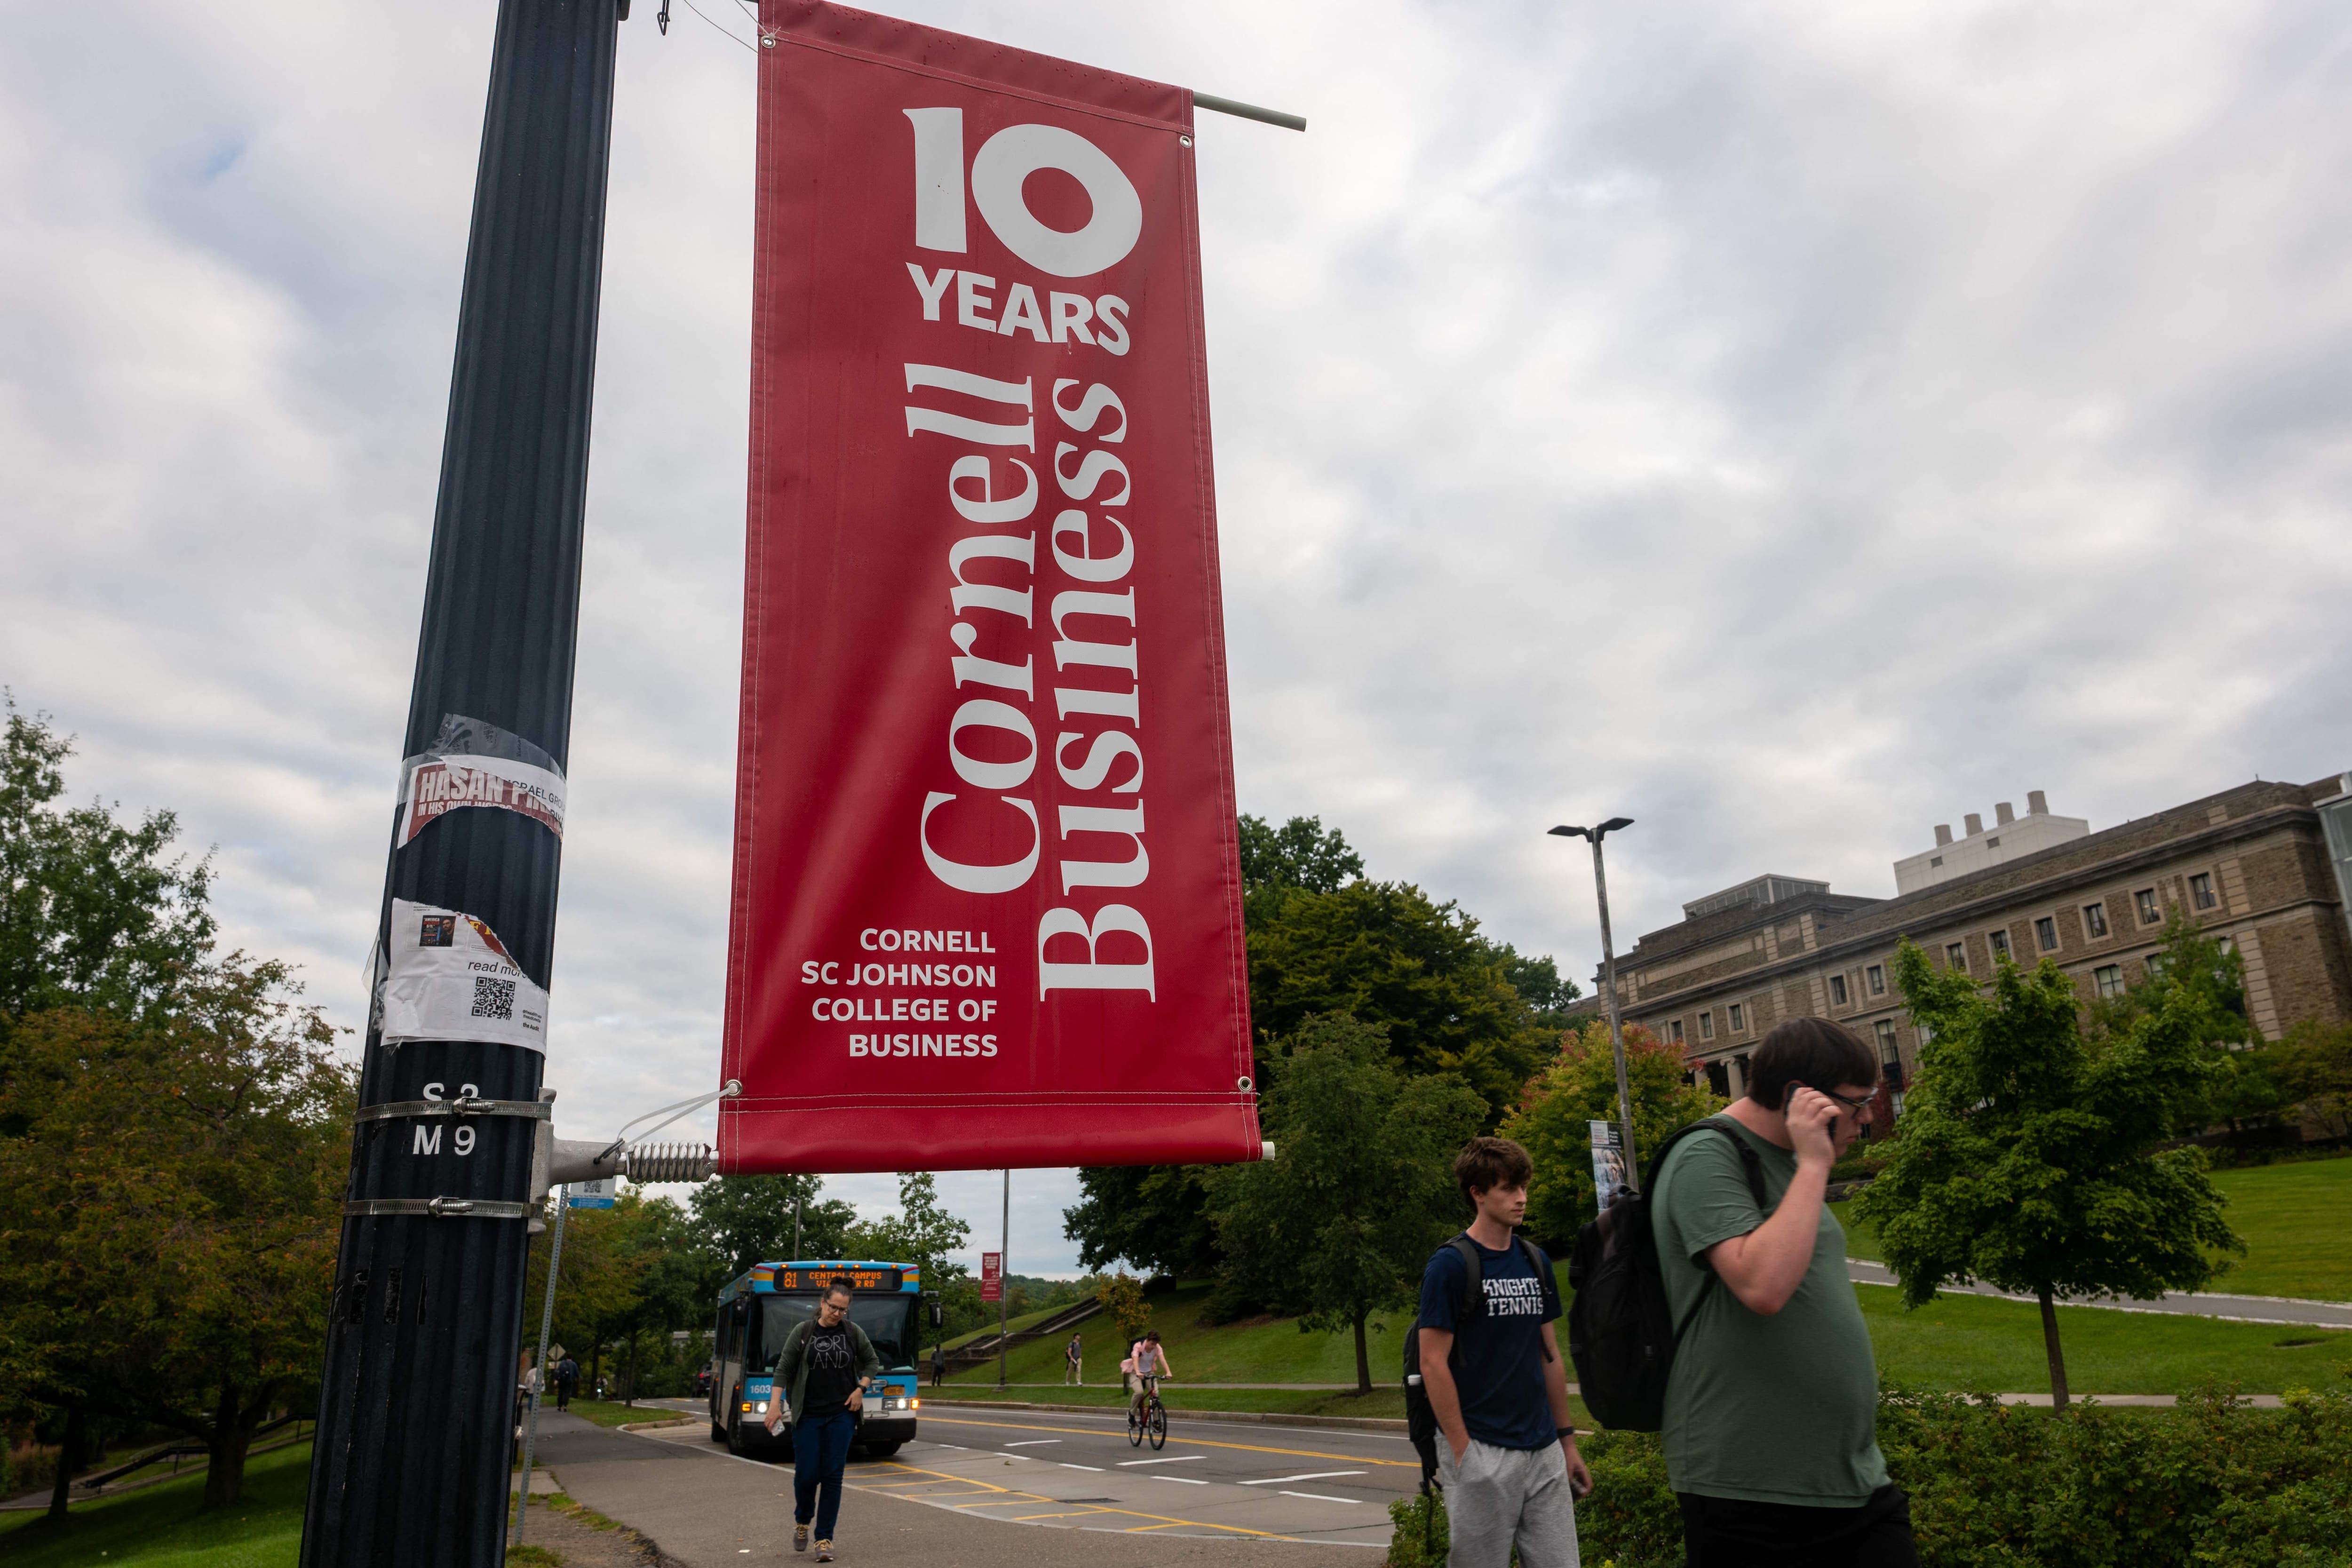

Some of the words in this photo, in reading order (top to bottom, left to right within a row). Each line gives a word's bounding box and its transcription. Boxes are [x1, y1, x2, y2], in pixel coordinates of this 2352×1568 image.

[902, 107, 1143, 278] 10
[905, 262, 1130, 356] YEARS
[904, 363, 1041, 894] Cornell
[1038, 378, 1156, 1003] Business
[419, 768, 504, 803] HASAN
[418, 803, 427, 817] IN
[428, 801, 445, 815] HIS
[860, 928, 996, 953] CORNELL
[468, 962, 499, 972] read
[801, 961, 839, 985] SC
[846, 963, 996, 987] JOHNSON
[812, 997, 949, 1021] COLLEGE
[958, 999, 997, 1022] OF
[850, 1034, 998, 1057] BUSINESS
[1486, 1297, 1543, 1316] TENNIS
[809, 1351, 850, 1369] AND
[750, 1385, 771, 1394] 1603
